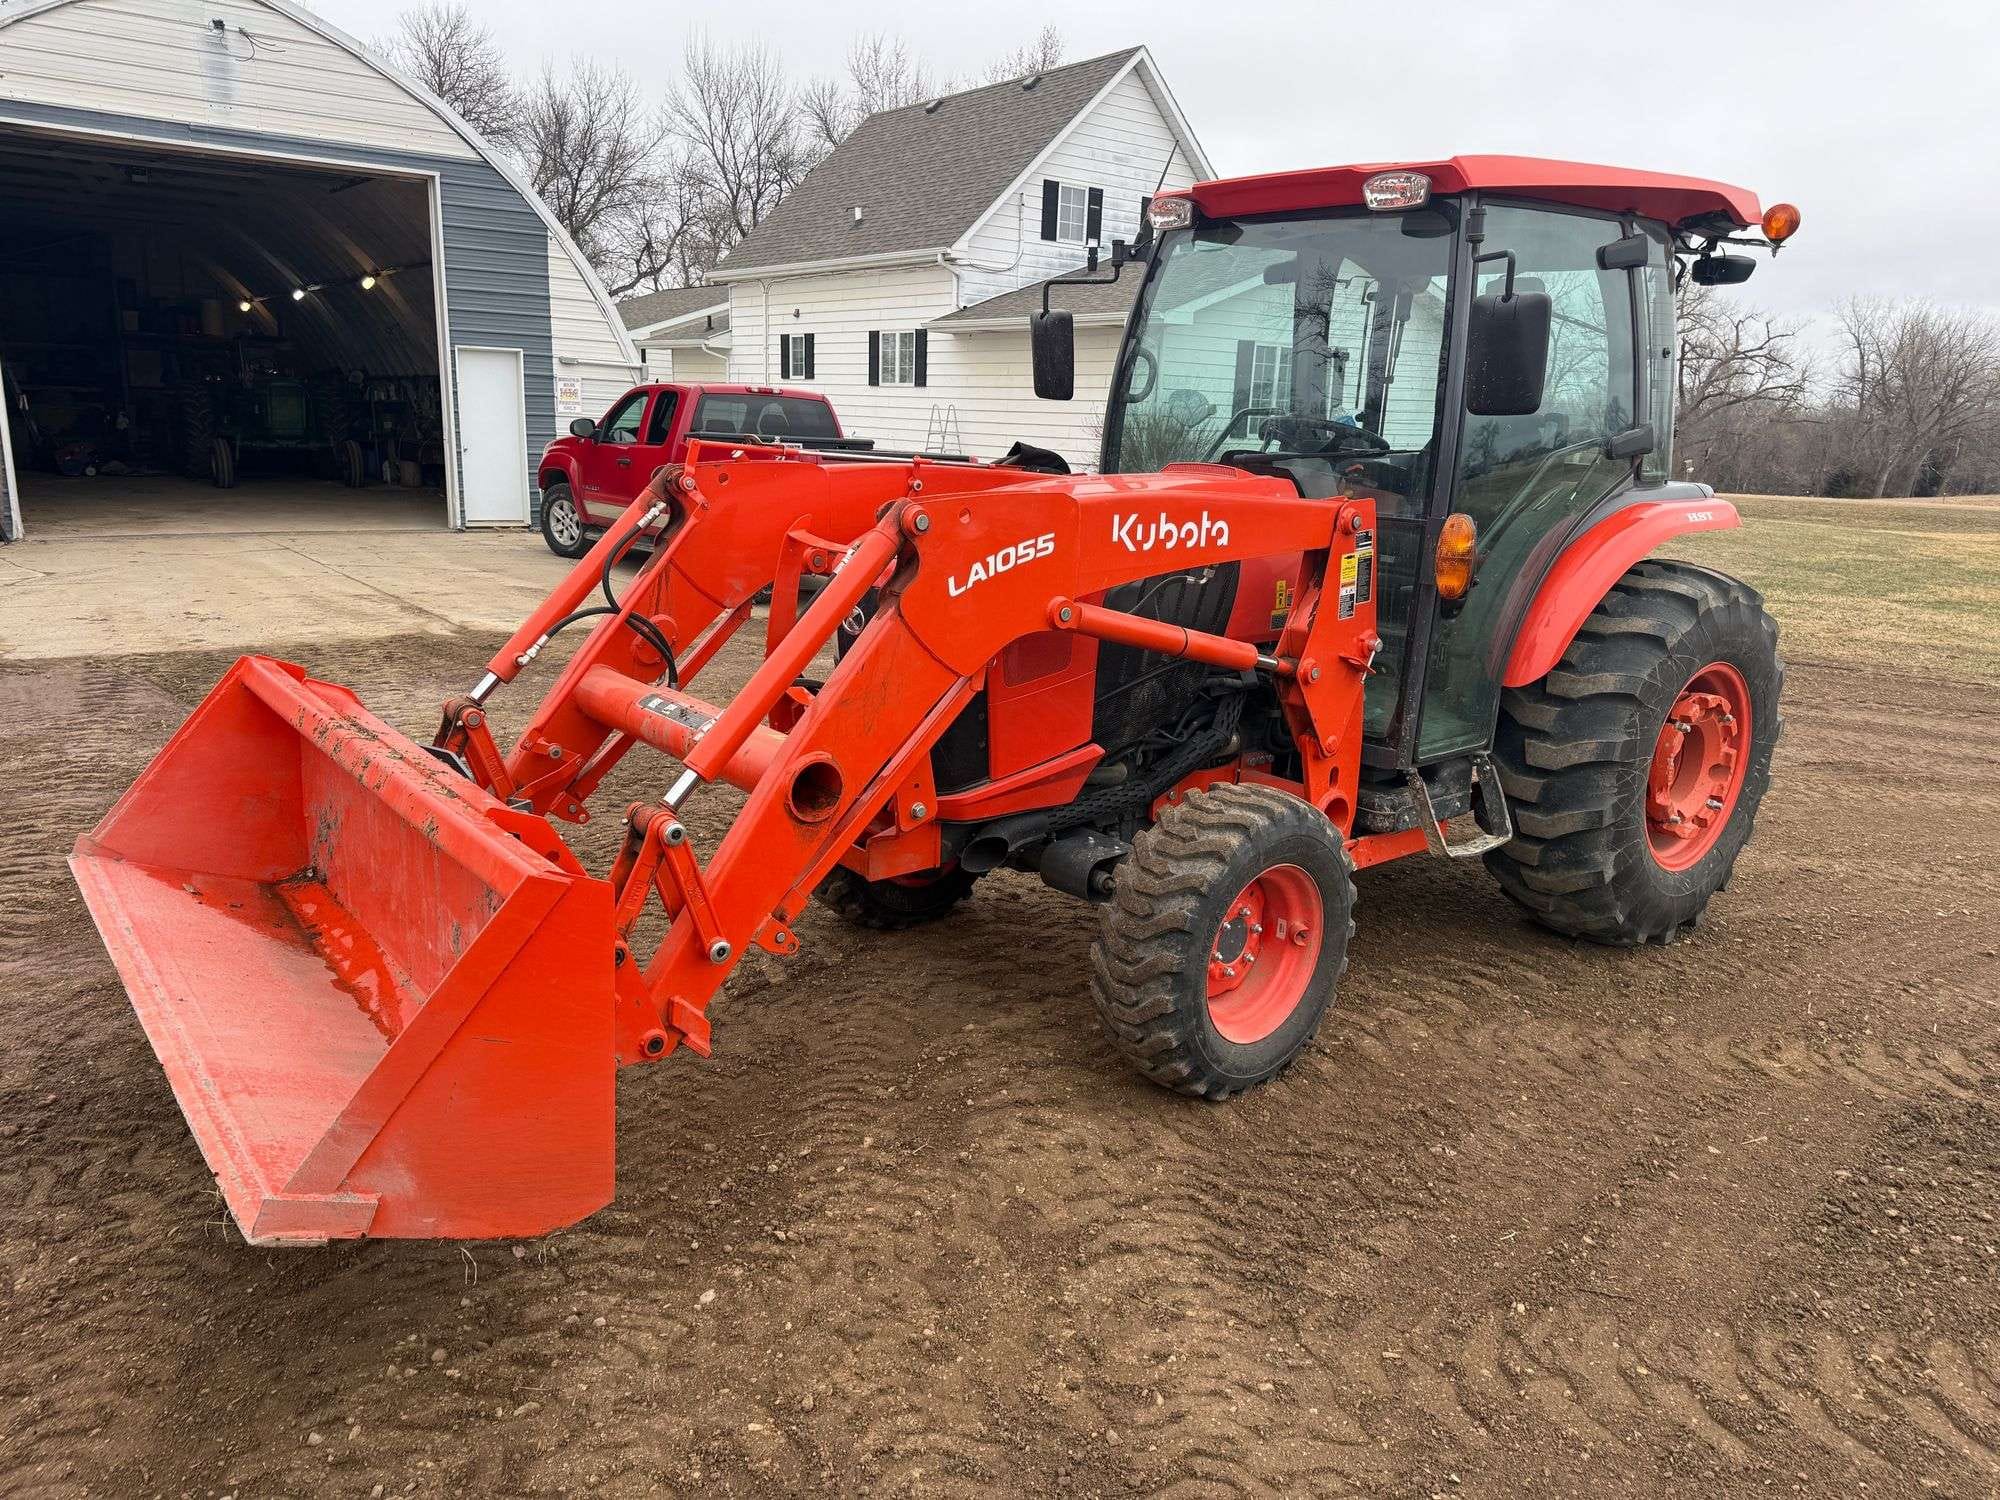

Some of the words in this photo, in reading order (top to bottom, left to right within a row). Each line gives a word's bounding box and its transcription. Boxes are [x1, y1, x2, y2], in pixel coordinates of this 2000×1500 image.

[1112, 511, 1229, 551] Kubota
[1686, 511, 1713, 522] HST
[948, 533, 1055, 597] LA1055
